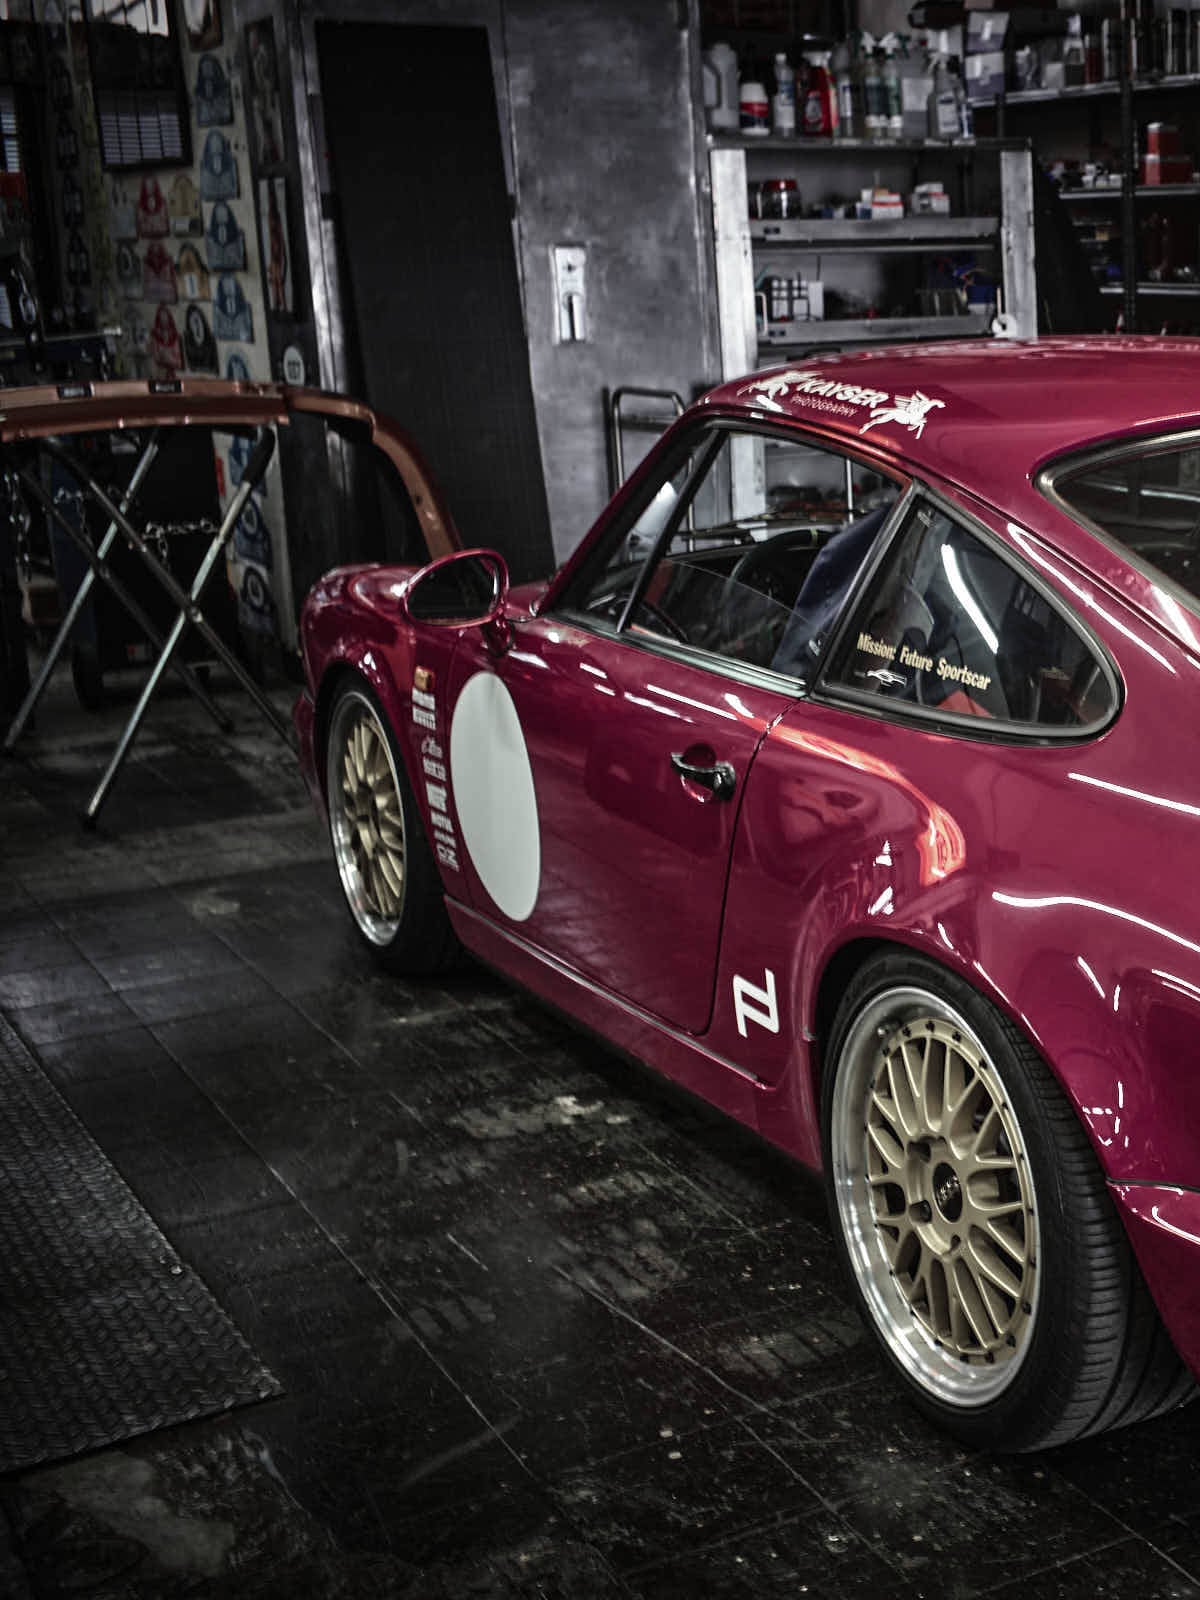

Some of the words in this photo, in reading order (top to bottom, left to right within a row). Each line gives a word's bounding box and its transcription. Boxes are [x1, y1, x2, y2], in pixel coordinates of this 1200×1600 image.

[790, 393, 858, 418] PHOTOGRAPHY
[857, 632, 897, 661] Mission:
[899, 644, 933, 672] Future
[937, 657, 992, 690] Sportscar
